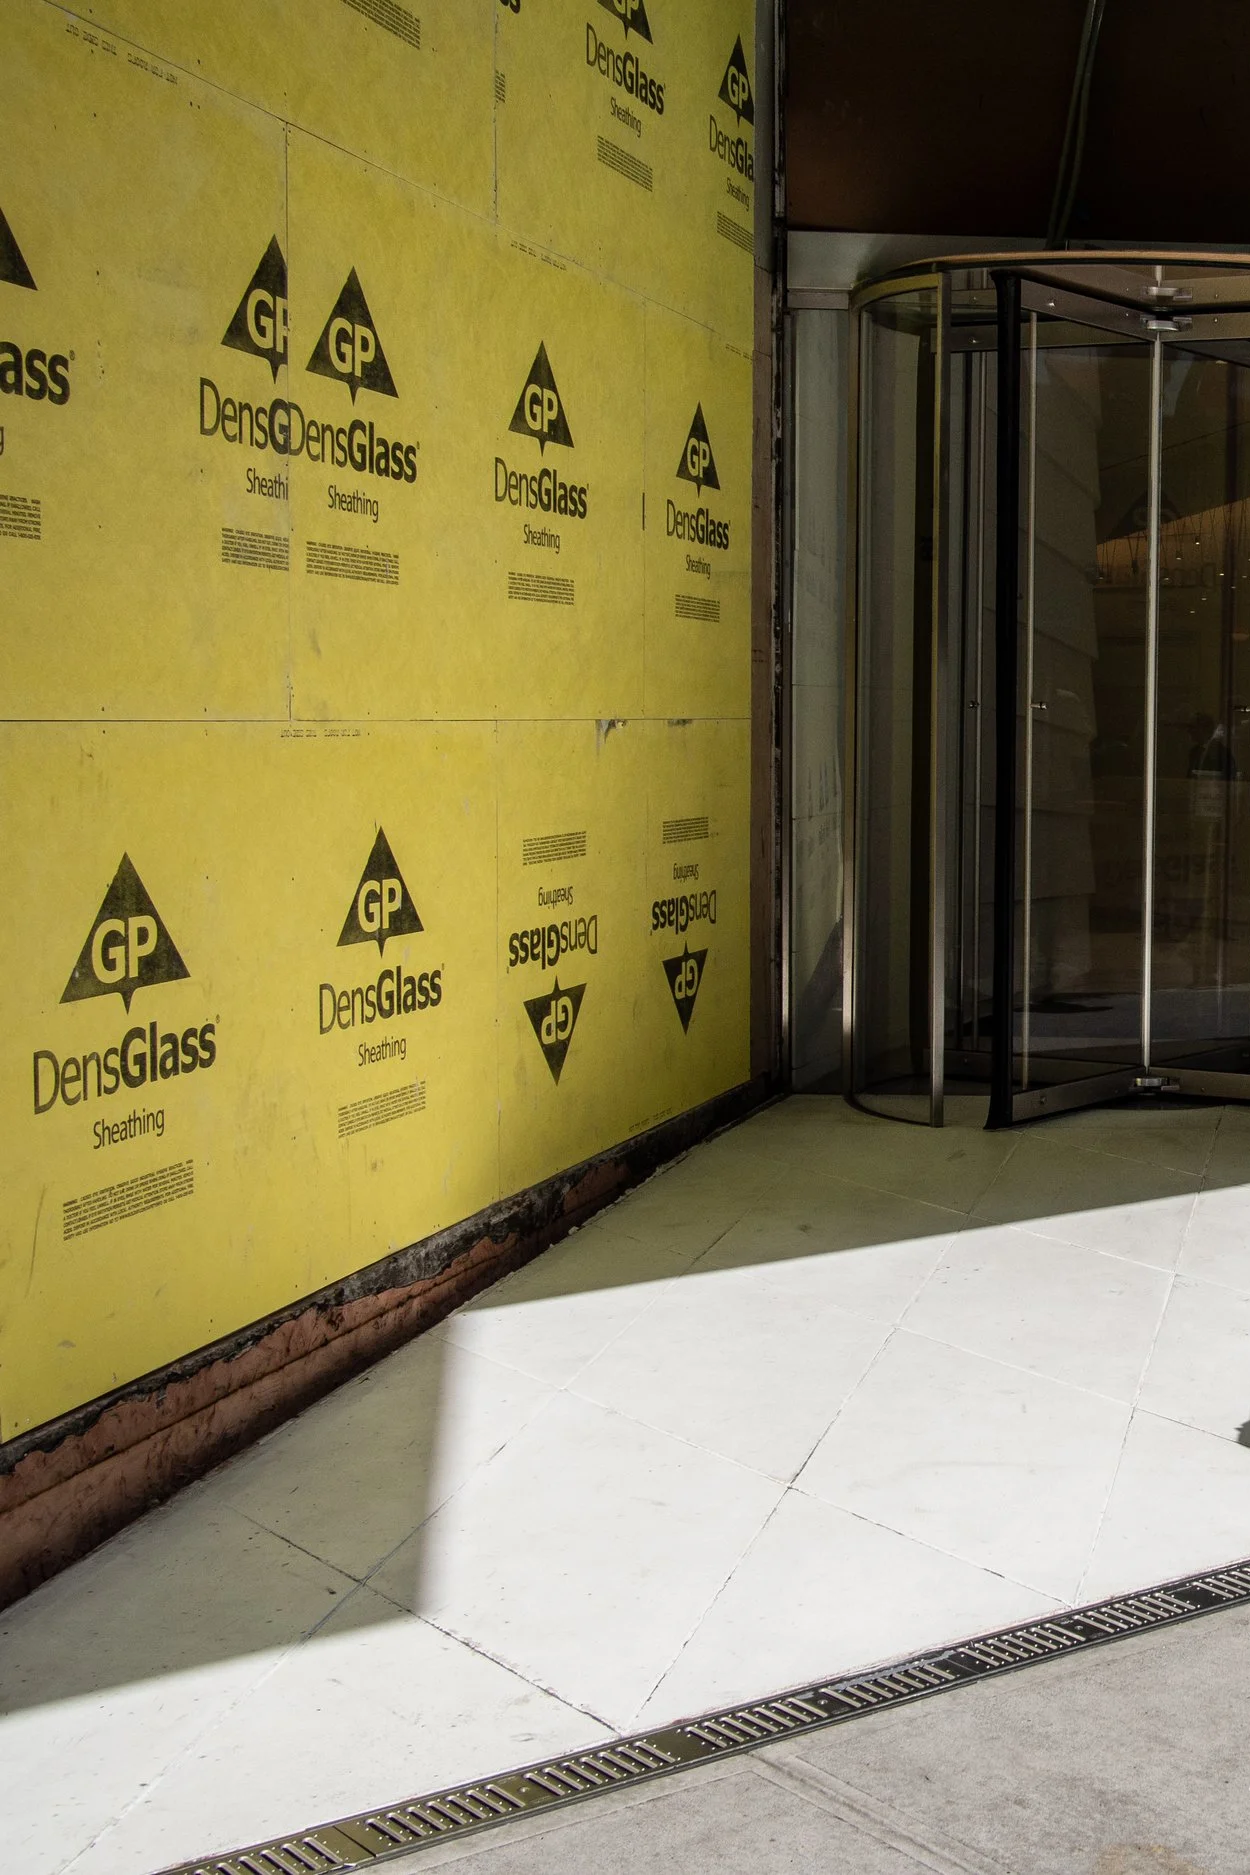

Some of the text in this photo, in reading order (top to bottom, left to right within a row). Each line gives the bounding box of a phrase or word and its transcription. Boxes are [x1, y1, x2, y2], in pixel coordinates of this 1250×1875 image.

[586, 21, 664, 115] DensGlass
[727, 65, 749, 110] GP
[610, 96, 641, 138] Sheathing
[727, 177, 750, 212] Sheathing
[328, 317, 376, 377] GP
[524, 383, 558, 433] GP
[686, 437, 710, 479] GP
[328, 484, 379, 524] Sheathing
[494, 456, 588, 520] DensGlass
[523, 523, 561, 554] Sheathing
[666, 498, 729, 550] DensGlass
[685, 554, 711, 579] Sheathing
[673, 862, 699, 883] Sheathing
[357, 878, 402, 933] GP
[538, 886, 574, 910] Sheathing
[652, 889, 717, 935] DensGlass
[91, 914, 158, 984] GP
[508, 914, 598, 970] DensGlass
[319, 965, 442, 1035] DensGlass
[674, 958, 699, 1000] GP
[541, 995, 574, 1045] GP
[33, 1020, 217, 1115] DensGlass
[357, 1036, 407, 1067] Sheathing
[93, 1108, 165, 1150] Sheathing
